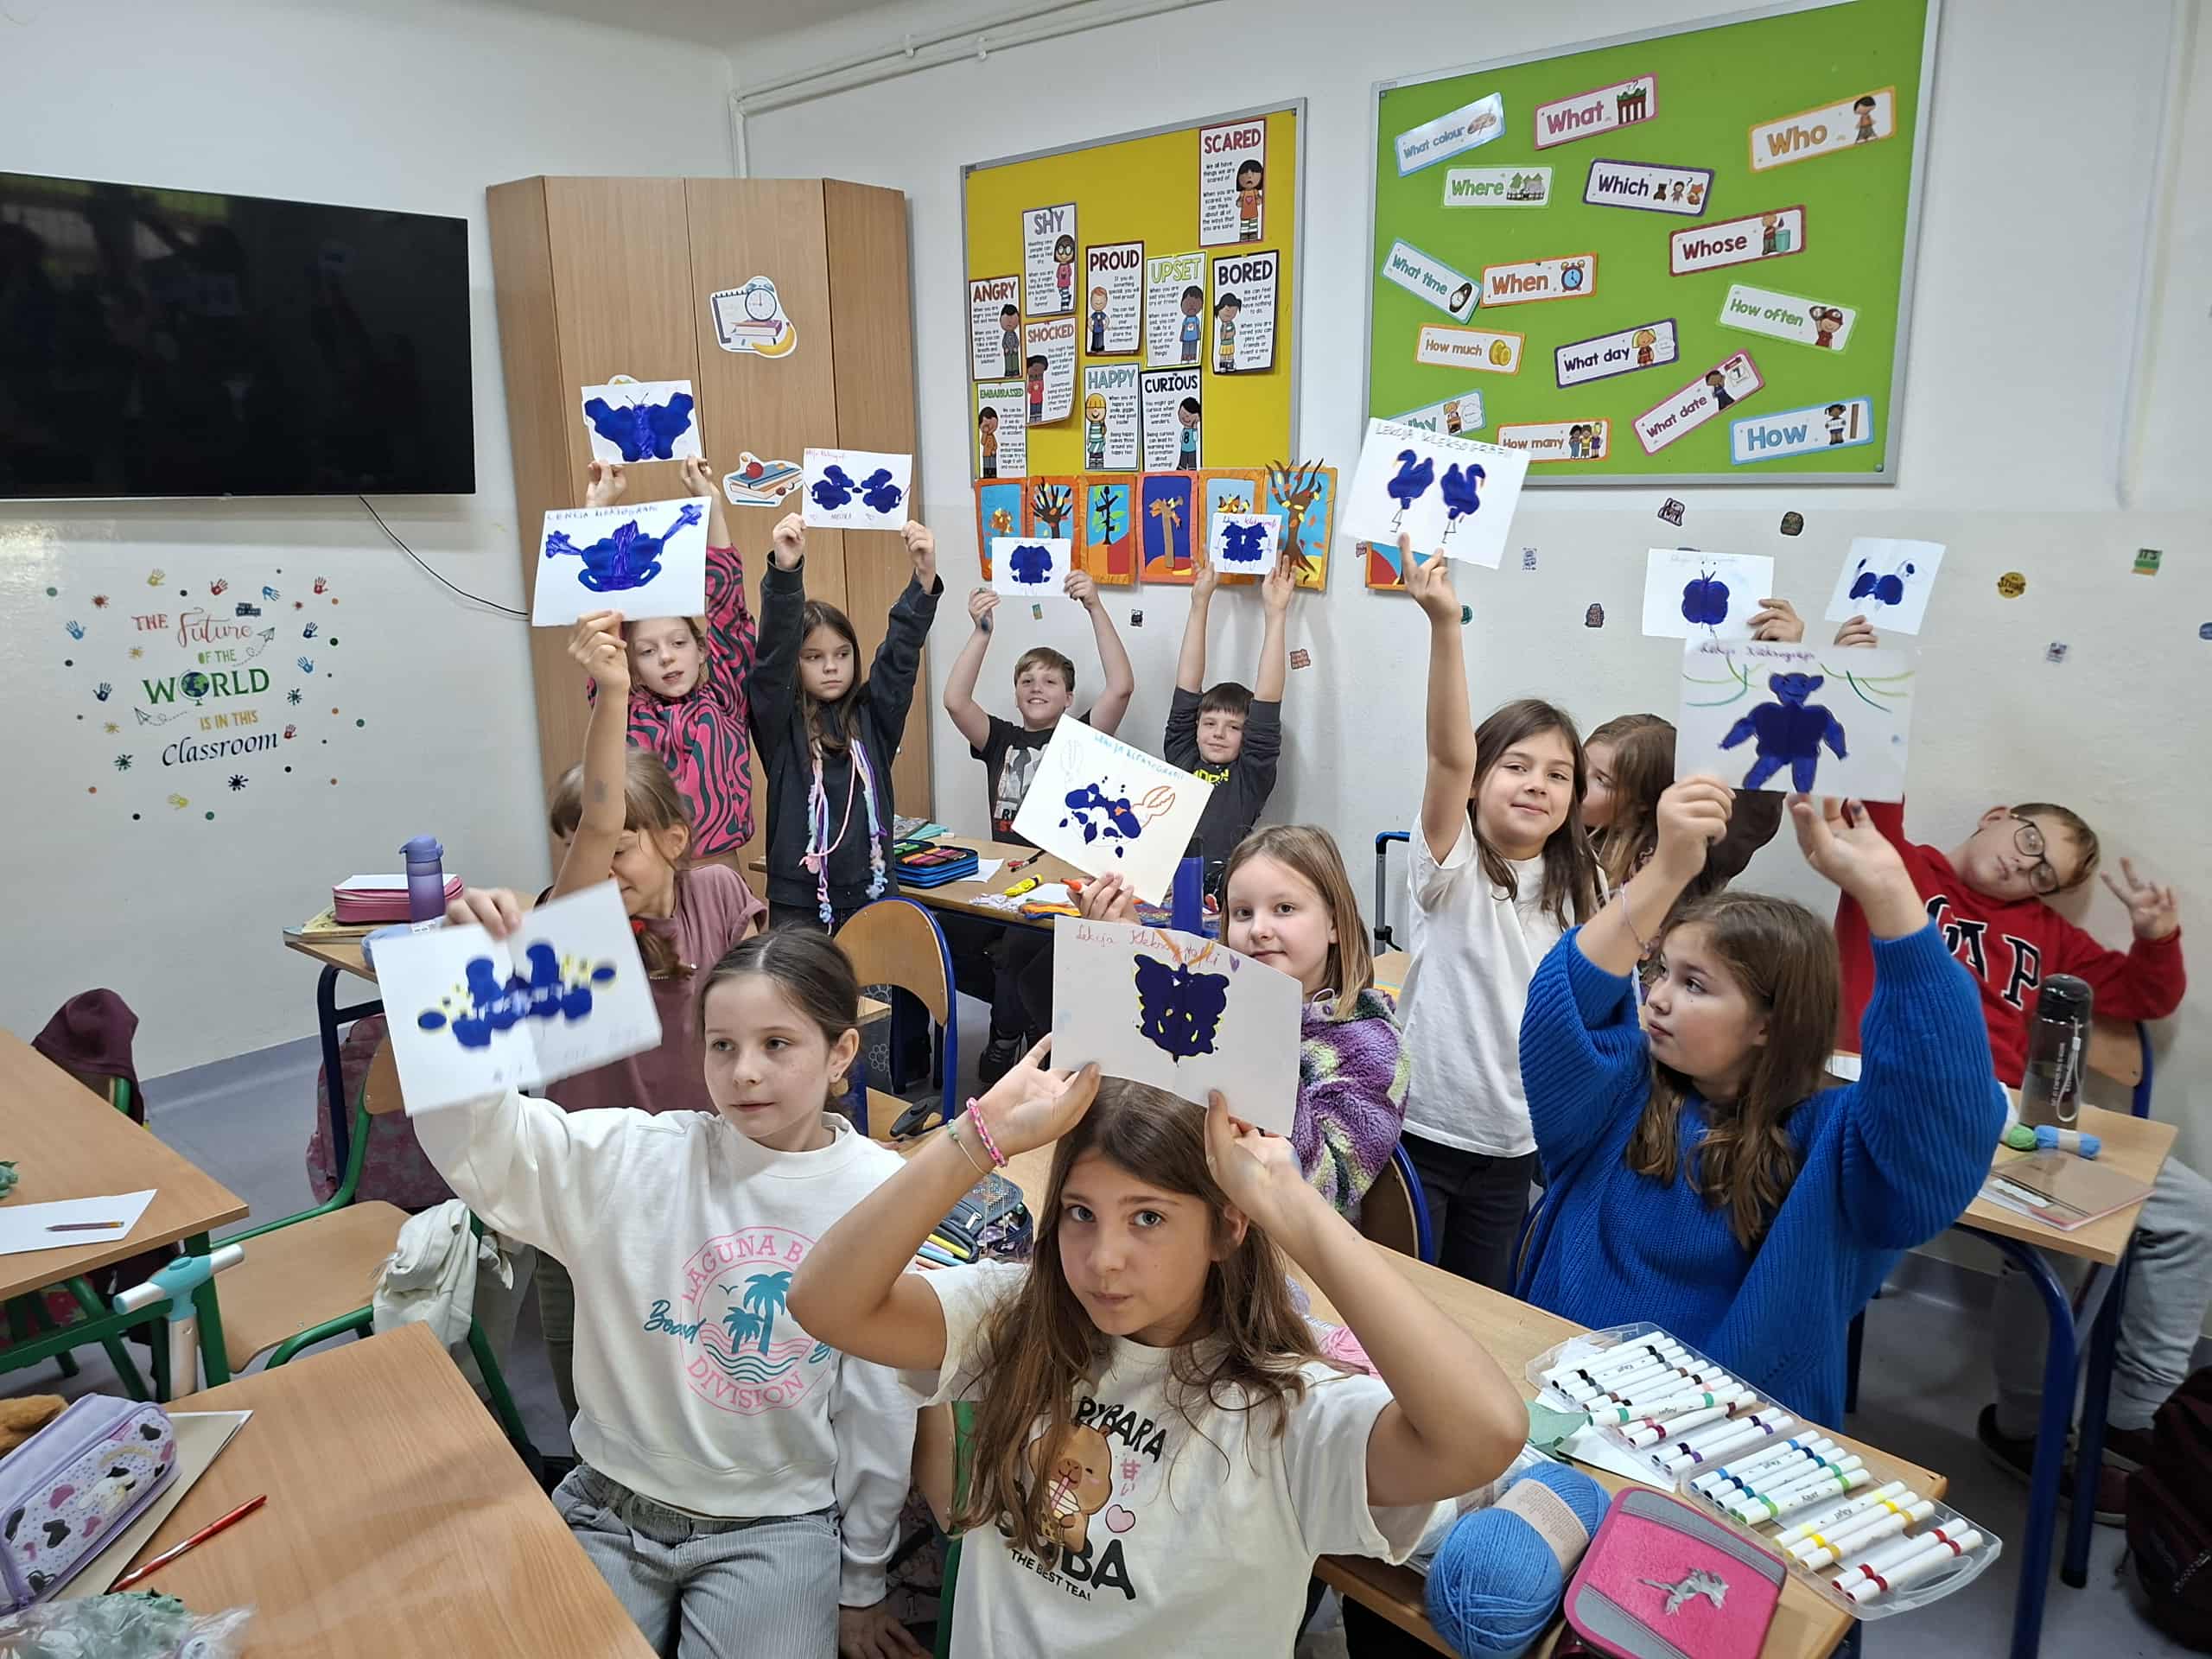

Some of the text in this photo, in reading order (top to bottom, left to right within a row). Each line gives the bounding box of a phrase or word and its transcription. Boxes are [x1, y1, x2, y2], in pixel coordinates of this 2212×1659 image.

[1547, 101, 1605, 134] What
[1205, 129, 1262, 154] SCARED
[1402, 125, 1465, 159] What colour
[1766, 124, 1827, 156] Who
[1452, 179, 1503, 196] Where
[1599, 175, 1649, 196] Which
[1033, 209, 1064, 235] SHY
[1682, 235, 1747, 260] Whose
[1090, 250, 1140, 271] PROUD
[1151, 258, 1201, 283] UPSET
[1218, 260, 1273, 285] BORED
[1391, 254, 1448, 296] What time
[1491, 274, 1549, 295] When
[973, 282, 1016, 302] ANGRY
[1730, 299, 1803, 327] How often
[1028, 324, 1073, 343] SHOCKED
[1425, 339, 1483, 357] How much
[1564, 347, 1630, 372] What day
[1088, 369, 1135, 389] HAPPY
[1145, 375, 1198, 393] CURIOUS
[1403, 416, 1437, 432] hy
[1646, 396, 1708, 438] What date
[1183, 431, 1190, 443] 8
[1503, 437, 1564, 450] How many
[1746, 424, 1808, 451] How
[131, 613, 168, 631] THE
[178, 607, 254, 648] Future
[198, 649, 236, 664] OF THE
[143, 669, 270, 706] WORLD
[200, 710, 258, 731] IS IN THIS
[162, 733, 278, 766] Classroom
[1925, 894, 2041, 1011] GAP
[682, 1235, 776, 1304] LAGUNA
[688, 1355, 804, 1409] DIVISION
[1073, 1395, 1166, 1464] PYBARA
[1010, 1548, 1091, 1601] THE BEST TEA!
